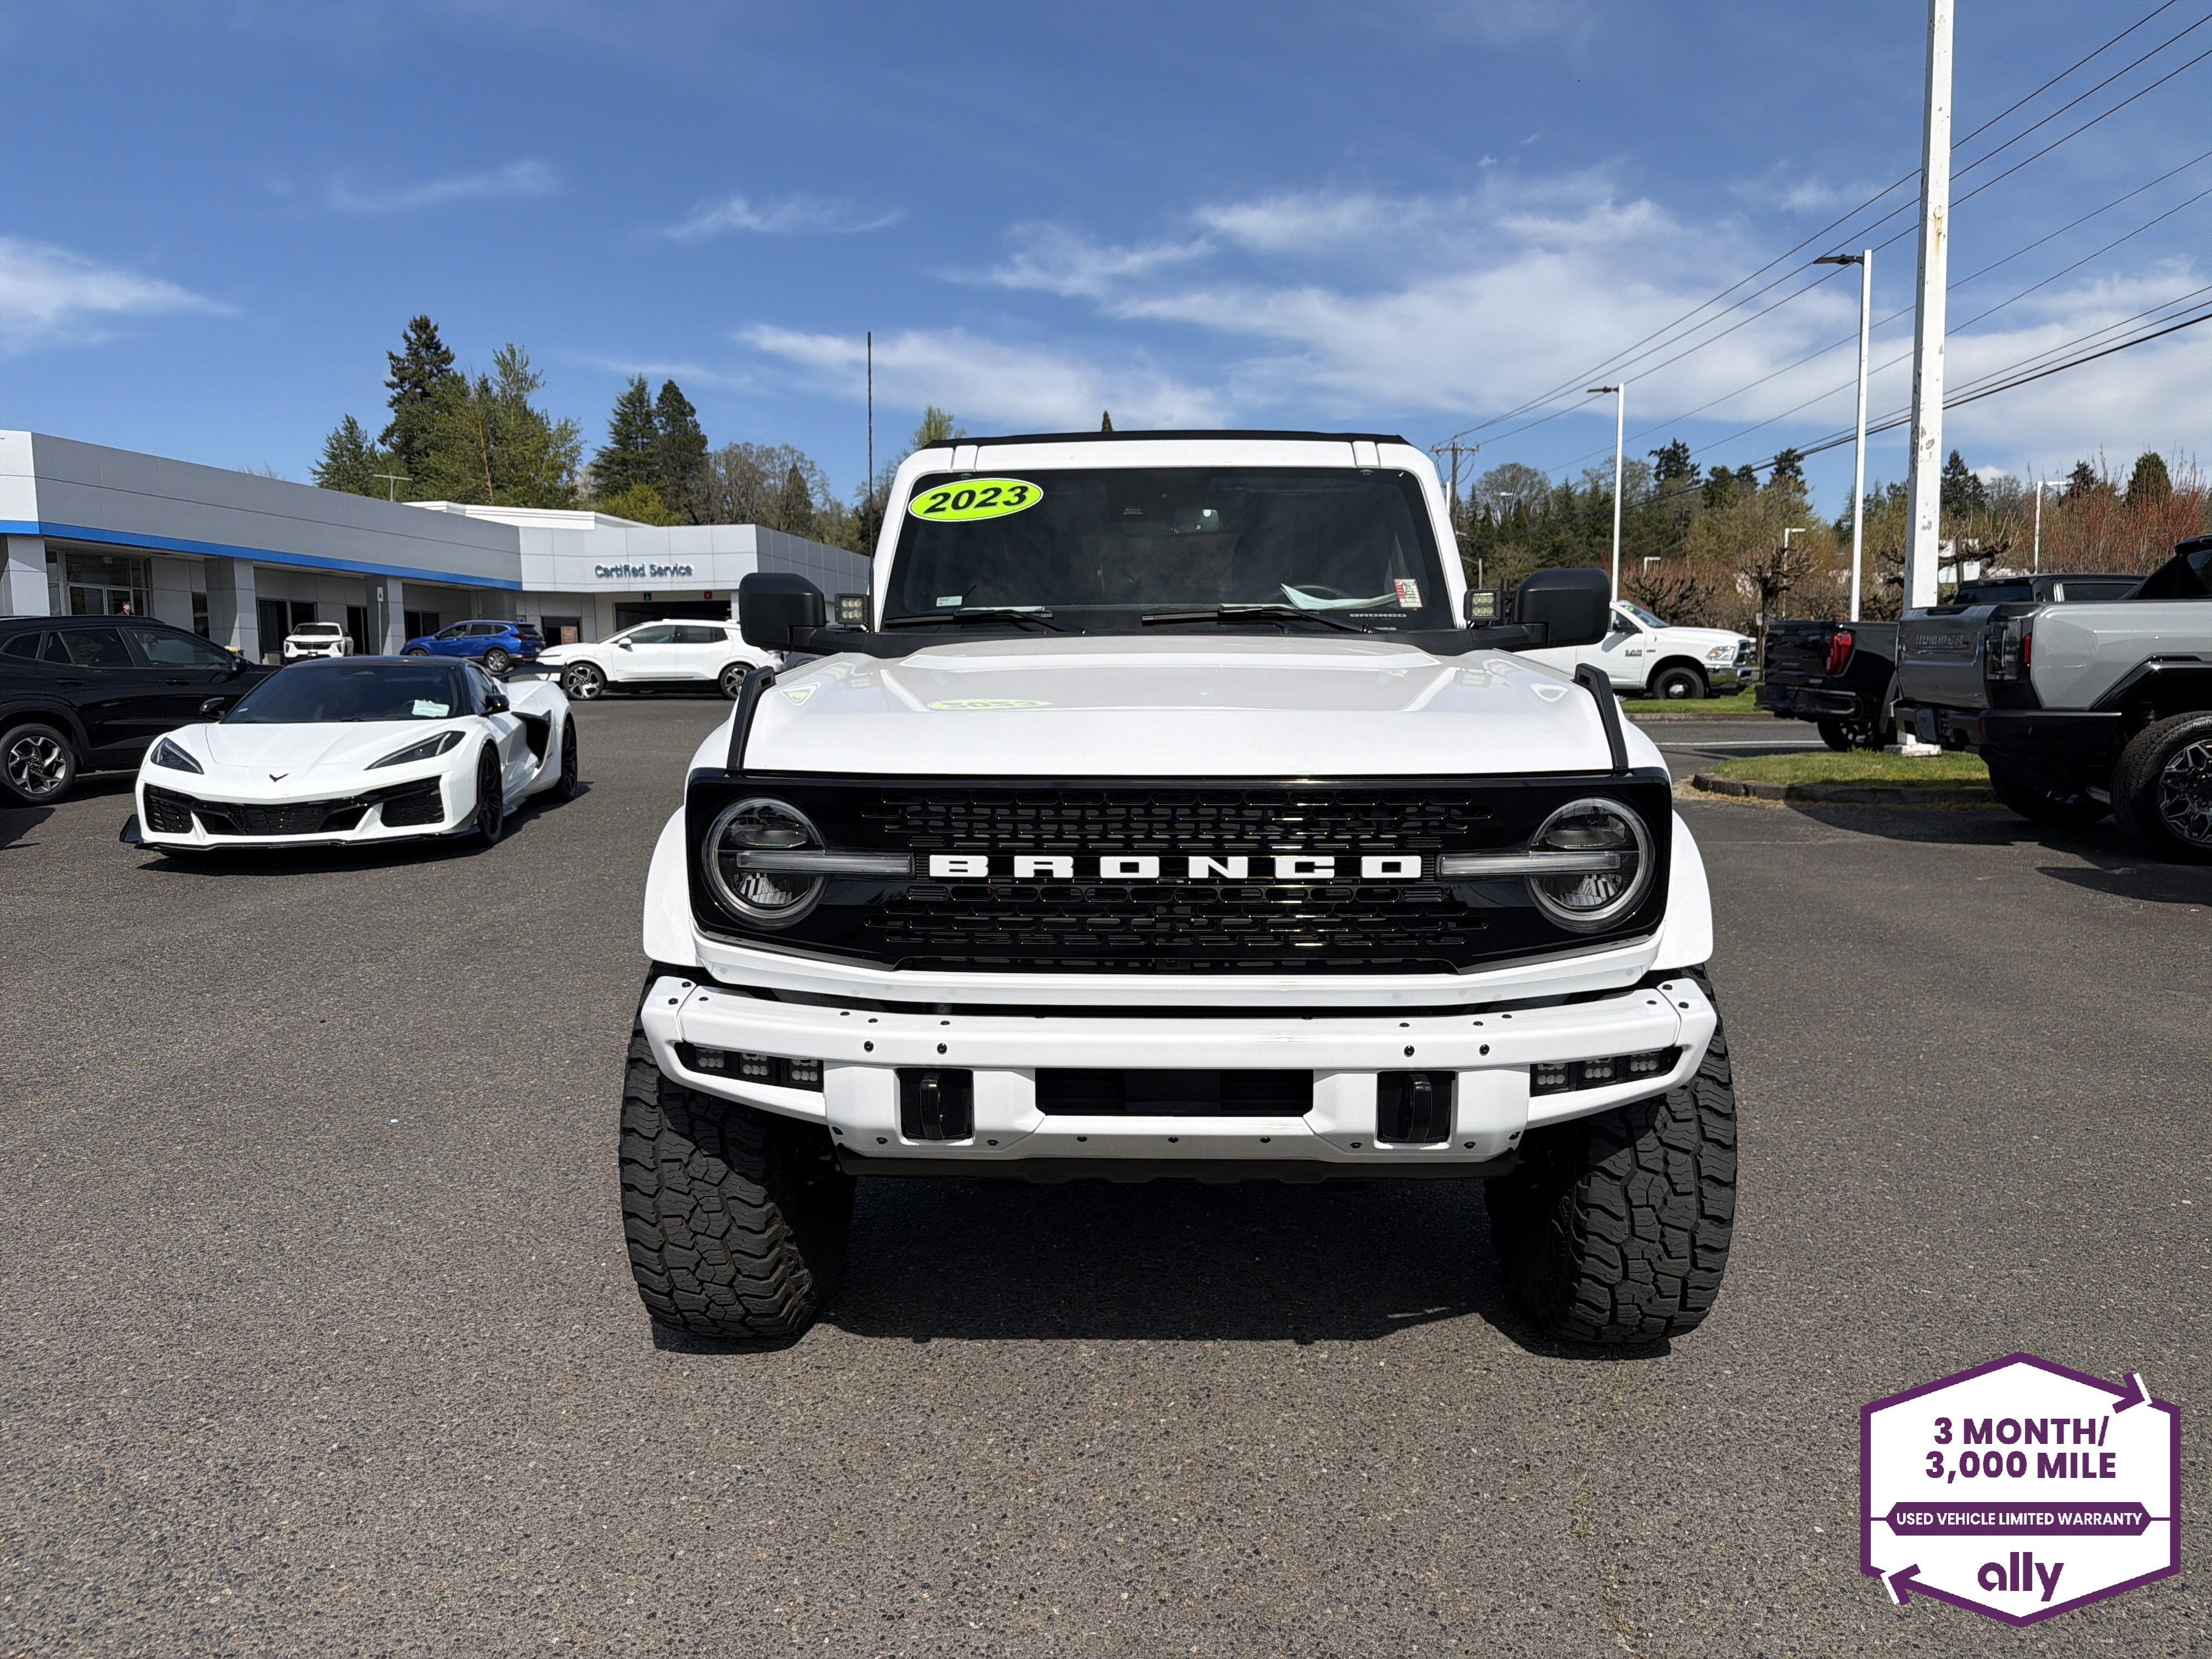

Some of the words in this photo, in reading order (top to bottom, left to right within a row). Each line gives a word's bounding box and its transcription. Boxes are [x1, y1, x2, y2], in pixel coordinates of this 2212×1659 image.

[923, 486, 1029, 515] 2023
[595, 563, 646, 578] Certified
[650, 563, 693, 577] Service
[929, 854, 1421, 879] BRONCO
